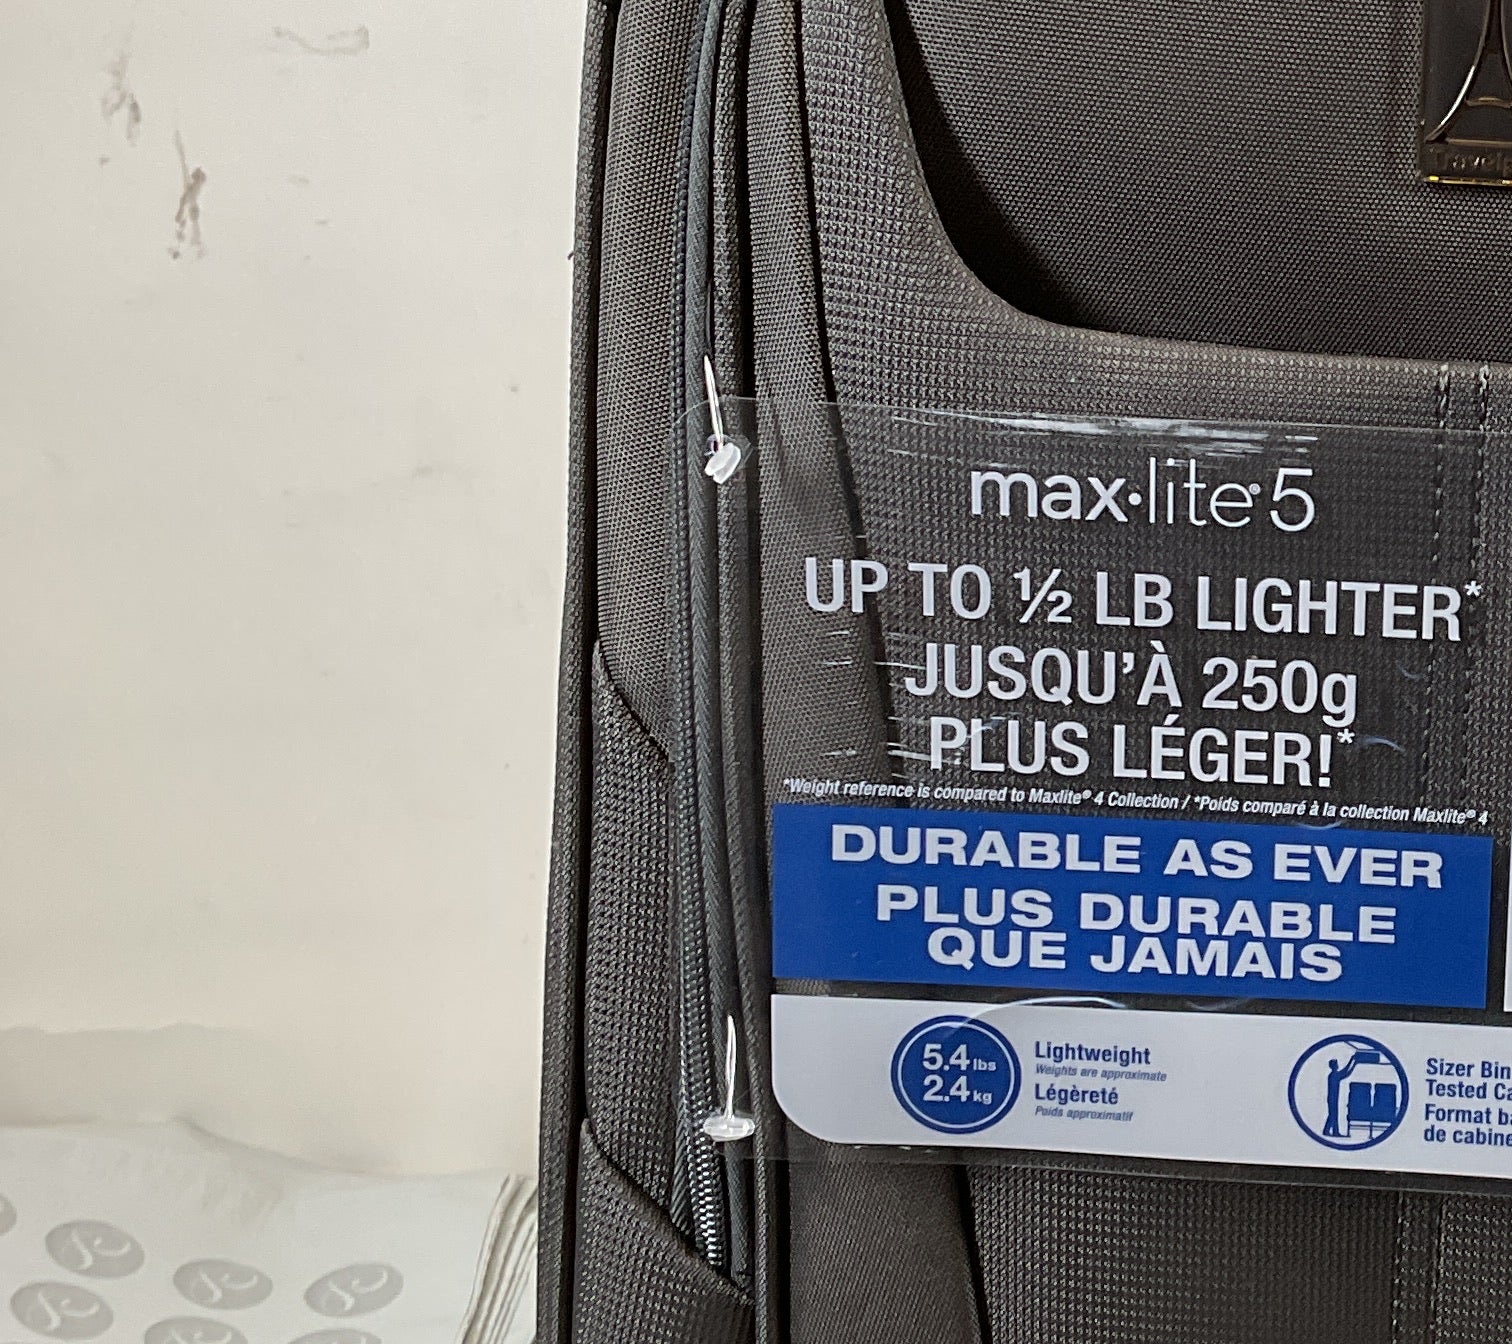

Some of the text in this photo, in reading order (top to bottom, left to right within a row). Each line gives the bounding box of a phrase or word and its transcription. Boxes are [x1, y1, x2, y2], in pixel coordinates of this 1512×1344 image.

[804, 556, 888, 614] UP
[908, 562, 992, 620] TO
[1097, 572, 1174, 627] LB
[1202, 658, 1358, 728] 250g
[930, 717, 1090, 778] PLUS
[843, 782, 914, 798] reference
[917, 784, 931, 798] is
[934, 784, 1007, 804] compared
[1010, 789, 1026, 803] to
[1094, 792, 1104, 805] 4
[1108, 791, 1179, 810] Collection
[1242, 798, 1307, 819] comparé
[1309, 800, 1320, 816] à
[1322, 802, 1336, 817] la
[1340, 803, 1409, 821] collection
[1478, 812, 1489, 825] 4
[831, 824, 1444, 890] DURABLE AS EVER
[877, 884, 1396, 943] PLUS DURABLE
[927, 927, 1343, 982] QUE JAMAIS
[922, 1043, 997, 1072] 5.4 lbs
[1034, 1041, 1150, 1067] Lightweight
[1035, 1063, 1167, 1082] Weights are approximate
[1426, 1058, 1512, 1080] Sizer Bin
[922, 1074, 993, 1105] 2.4 kg
[1034, 1083, 1119, 1106] Légèreté
[1426, 1079, 1487, 1100] Tested
[1035, 1105, 1134, 1122] Poids approximatif
[1424, 1103, 1492, 1125] Format
[1423, 1125, 1446, 1143] de
